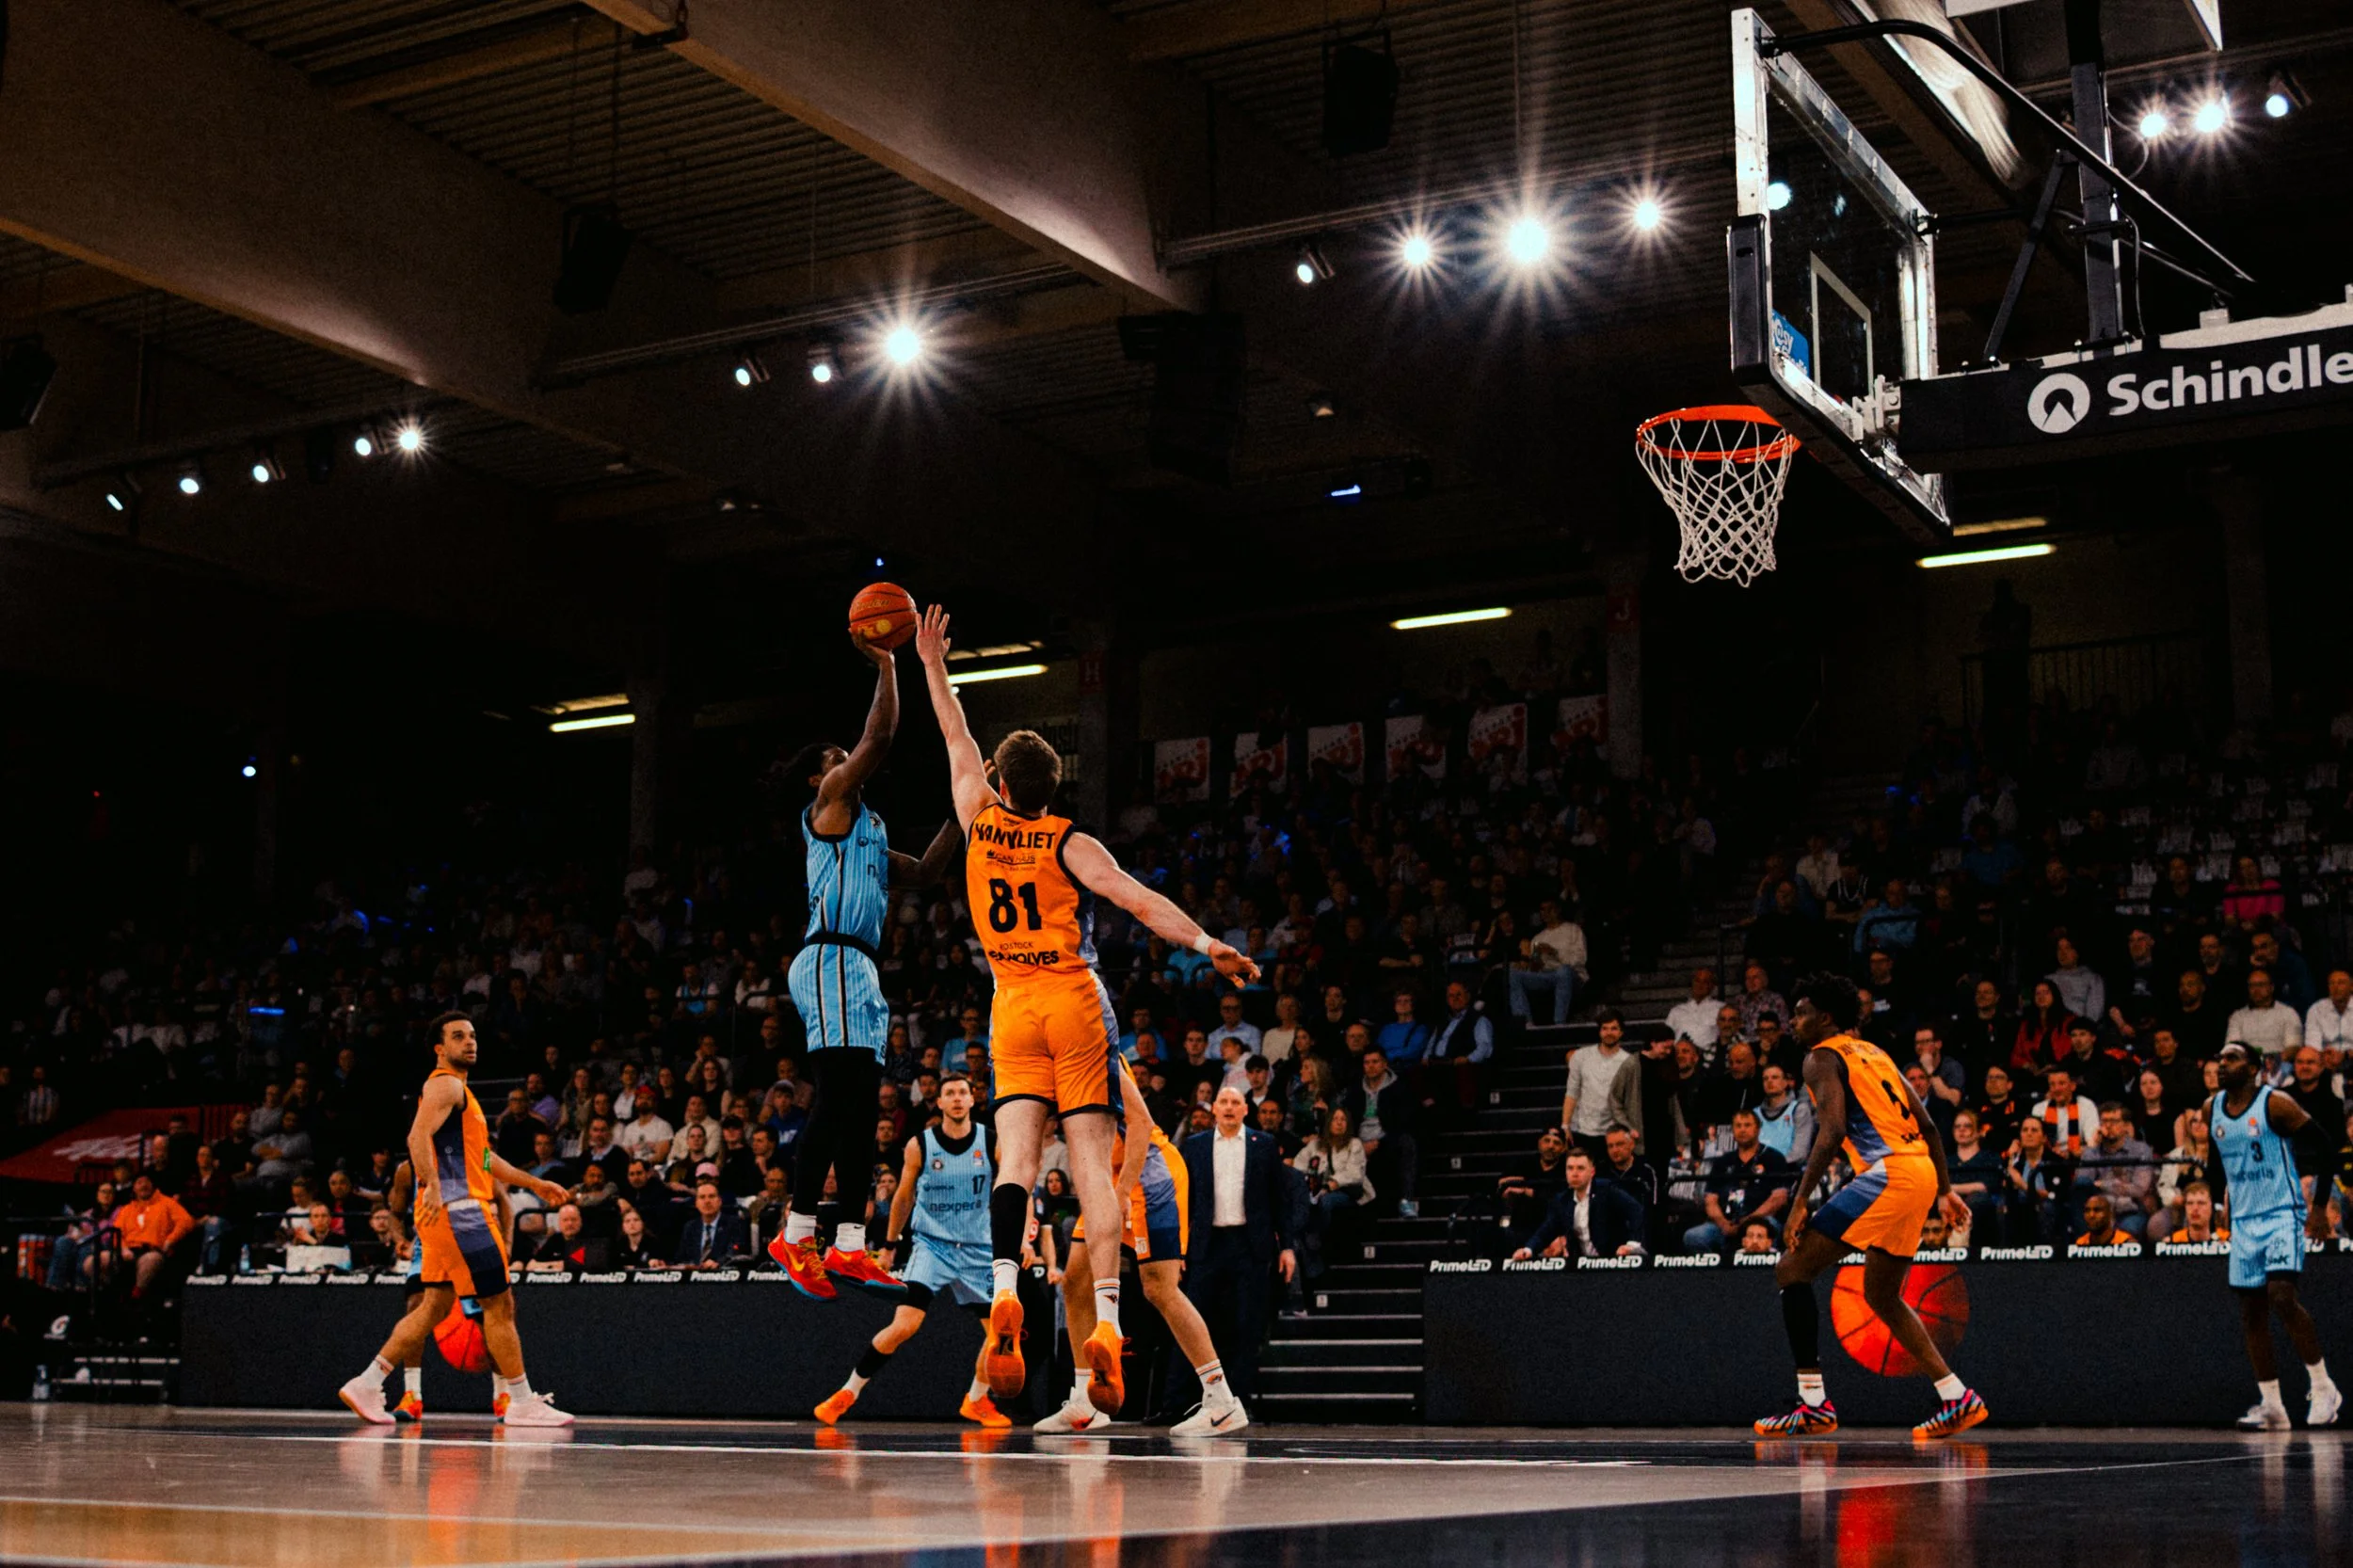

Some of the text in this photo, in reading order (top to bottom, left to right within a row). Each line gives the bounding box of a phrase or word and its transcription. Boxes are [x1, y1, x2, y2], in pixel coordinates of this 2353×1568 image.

[988, 878, 1042, 933] 81
[2250, 1141, 2264, 1162] 3
[972, 1175, 985, 1195] 17
[1980, 1244, 2054, 1260] PrimeLED
[2067, 1242, 2142, 1258] PrimeLED
[1429, 1259, 1493, 1272] PrimeLED
[1577, 1256, 1643, 1270] PrimeLED
[1654, 1253, 1721, 1268] PrimeLED
[632, 1271, 682, 1283] PrimeLED
[690, 1271, 741, 1283] PrimeLED
